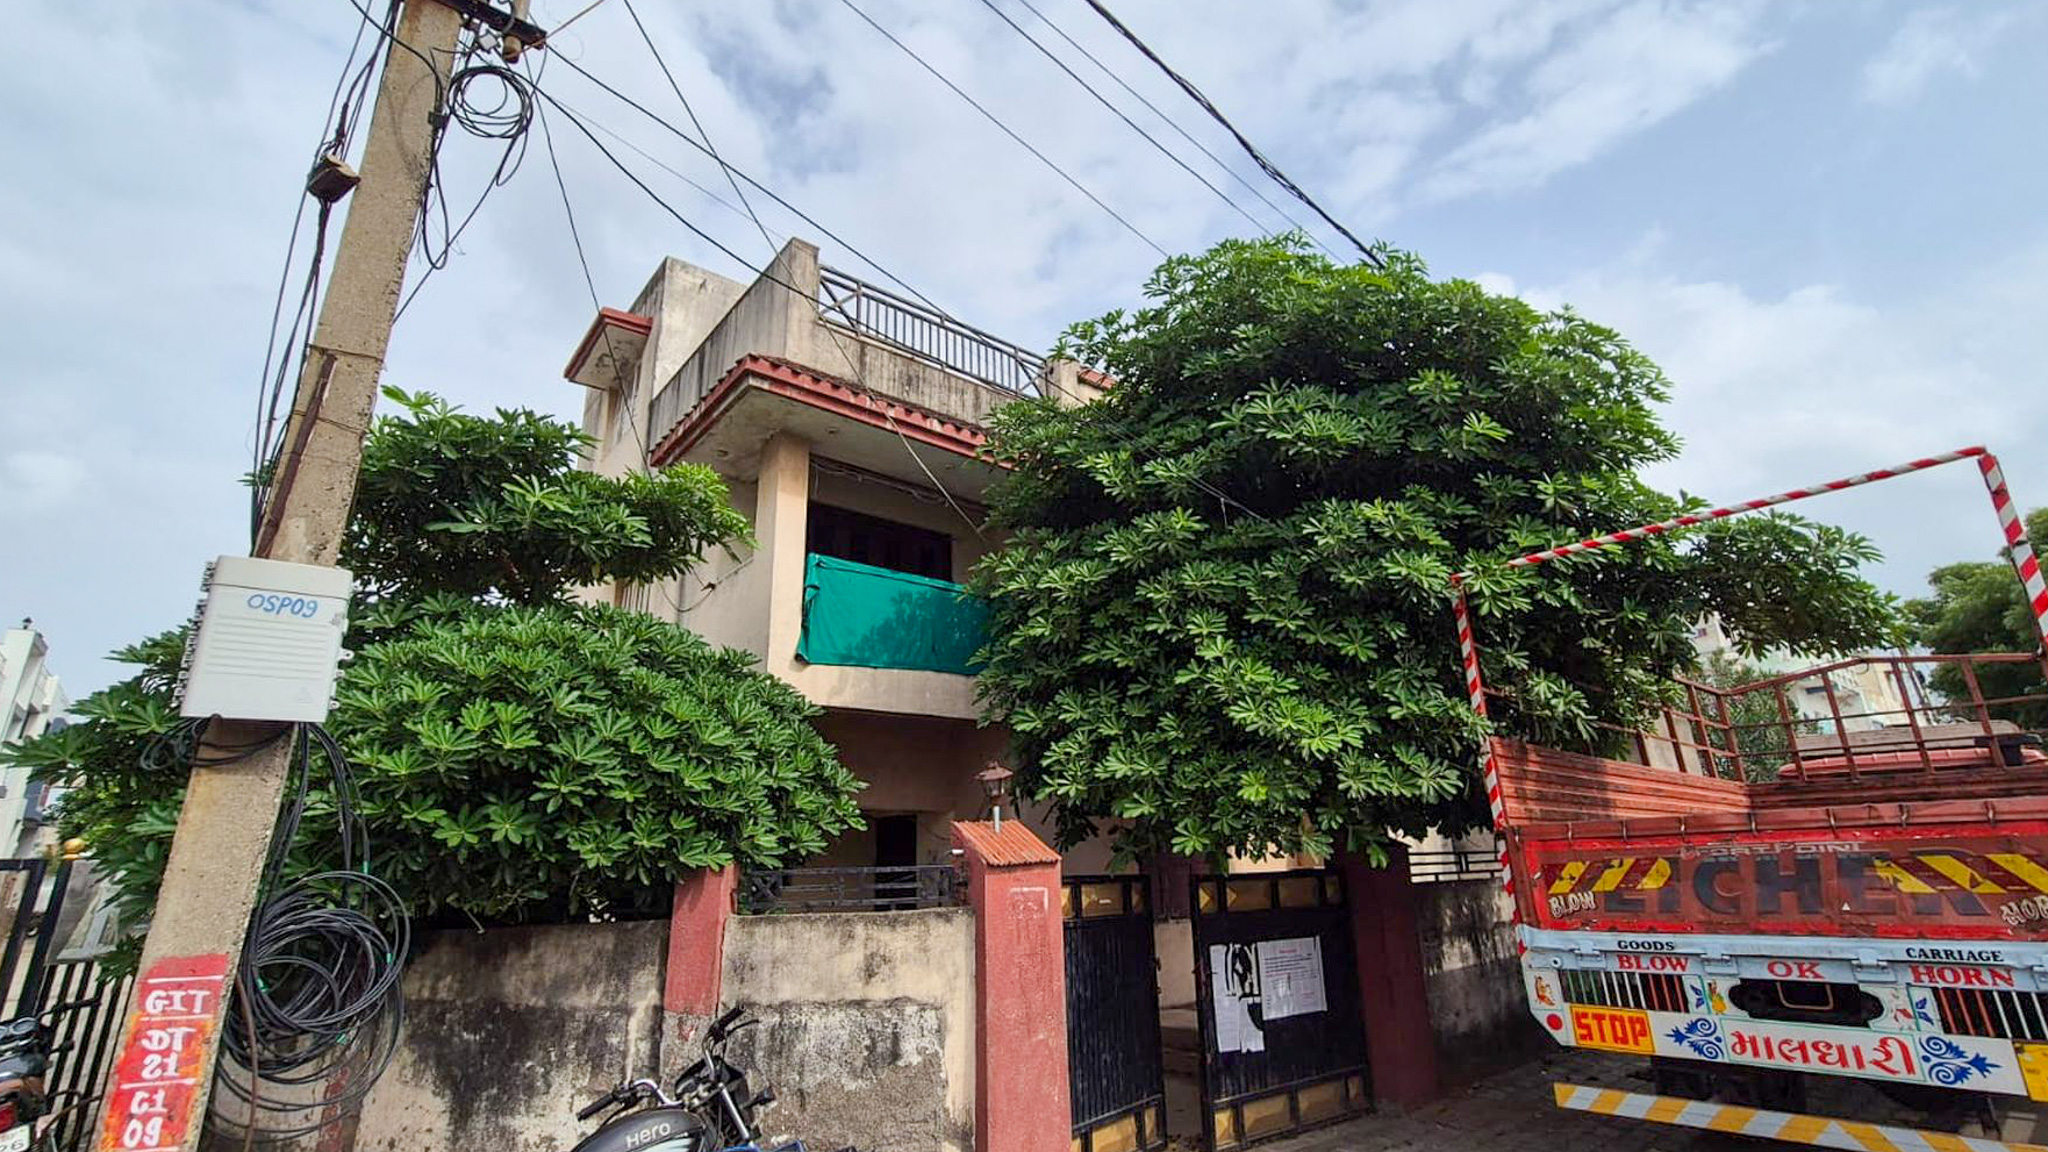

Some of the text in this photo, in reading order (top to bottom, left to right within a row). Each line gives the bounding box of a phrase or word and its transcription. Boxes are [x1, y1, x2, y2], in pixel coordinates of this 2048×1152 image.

[247, 594, 318, 618] OSP09
[1549, 891, 1597, 918] BLOW
[1617, 940, 2004, 962] GOODS CARRIAGE
[1617, 954, 2014, 987] BLOW OK HORN
[145, 990, 211, 1013] GIT
[141, 1027, 197, 1050] DT
[1574, 1012, 1648, 1046] STOP
[1731, 1031, 1916, 1076] માલધારી
[123, 1117, 163, 1148] 09
[626, 1123, 671, 1148] Hero
